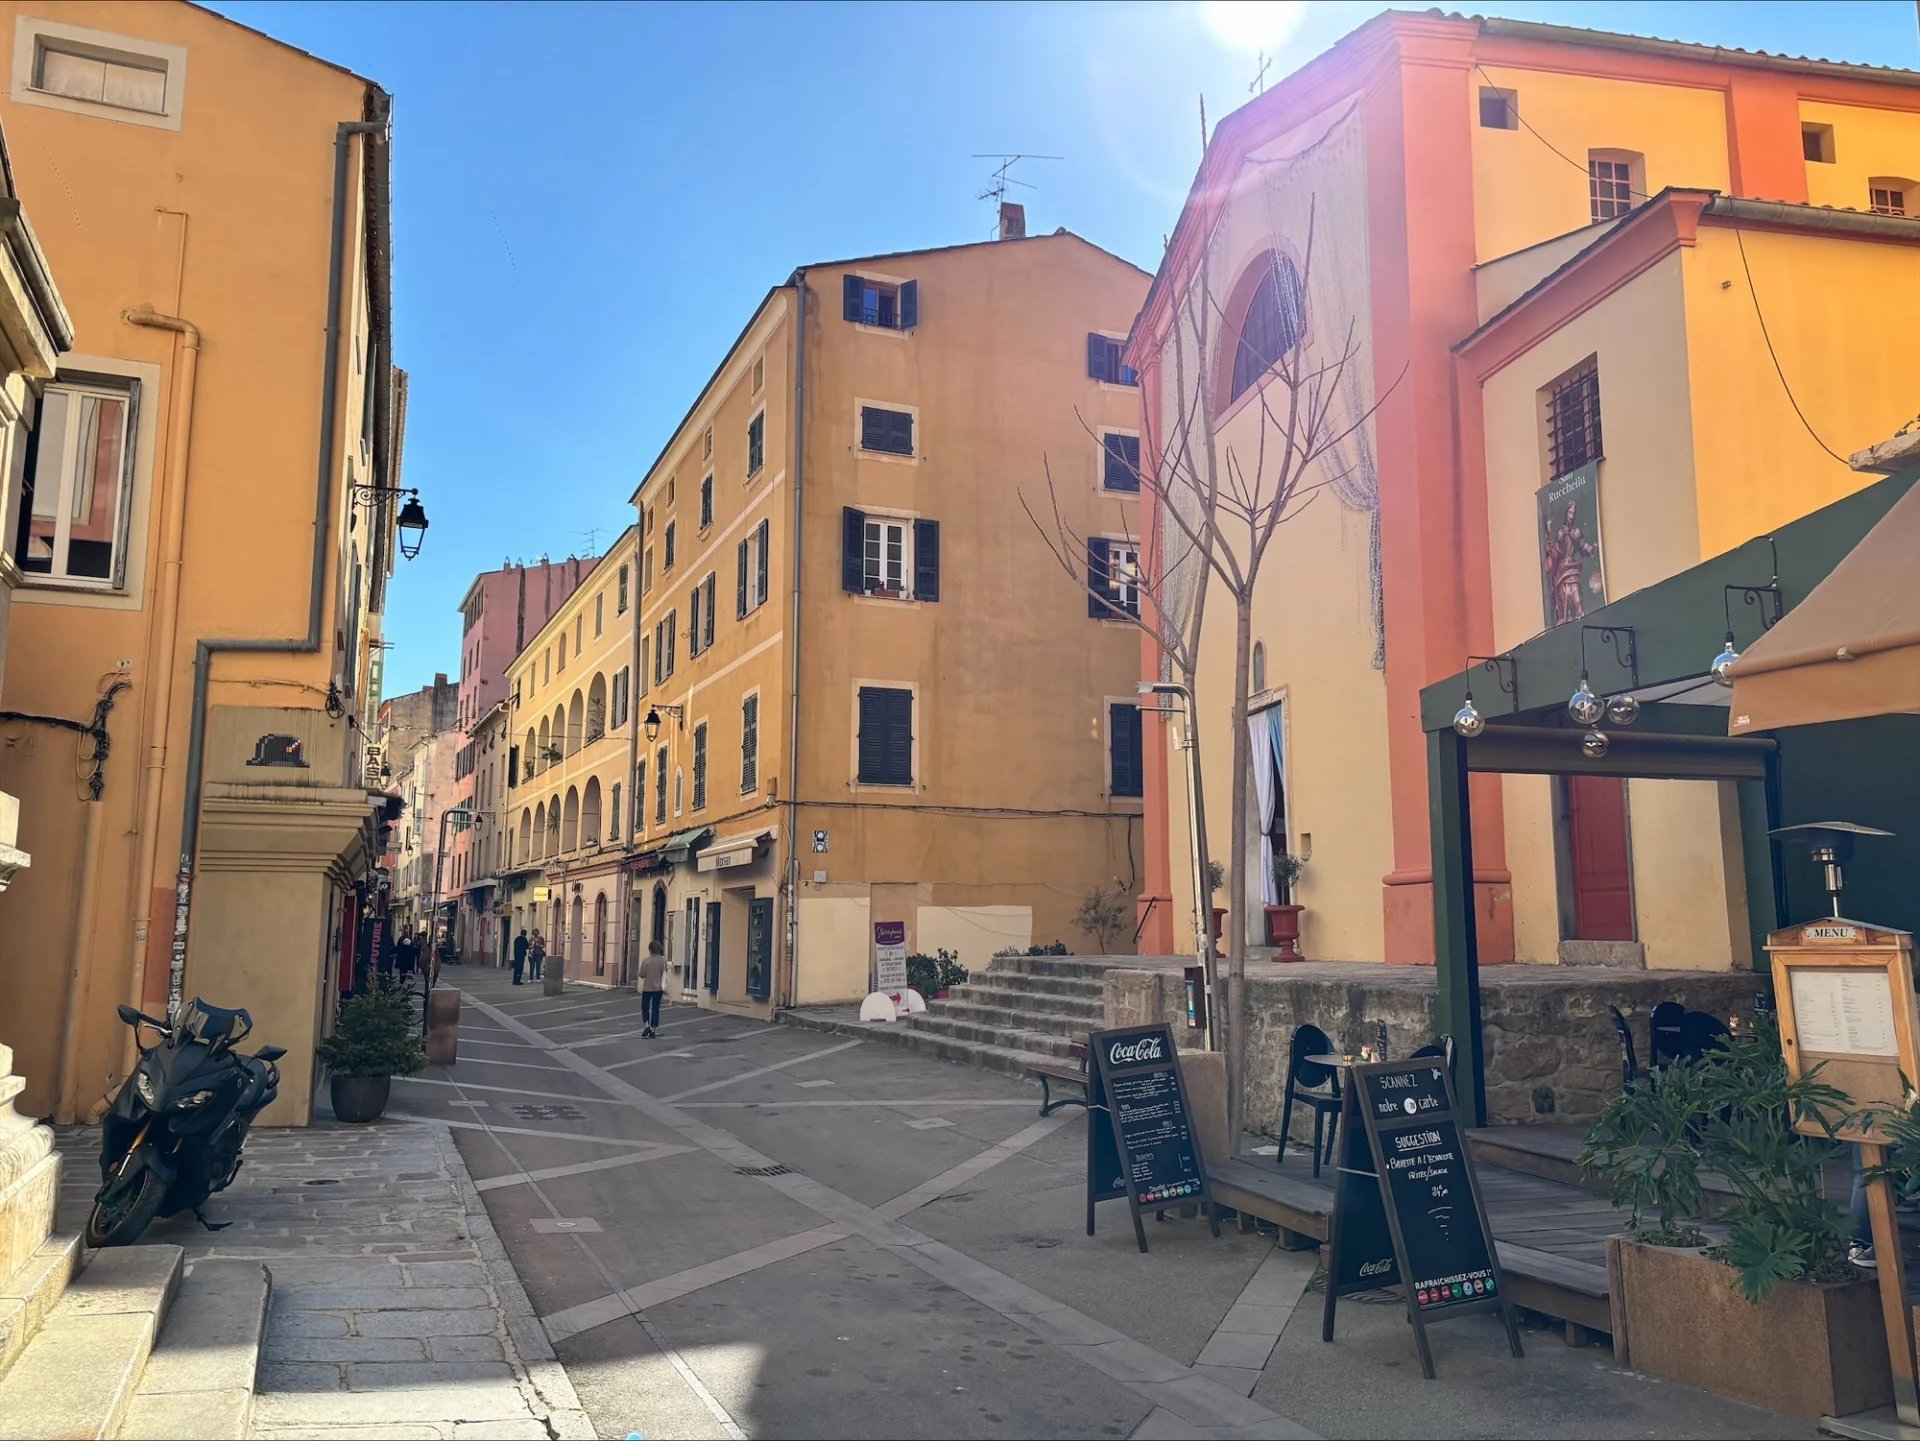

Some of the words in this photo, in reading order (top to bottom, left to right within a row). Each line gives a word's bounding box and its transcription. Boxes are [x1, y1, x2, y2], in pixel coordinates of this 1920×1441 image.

[1814, 928, 1848, 938] MENU
[1110, 1037, 1162, 1065] Coca-Cola
[1380, 1074, 1418, 1090] SCANNEZ
[1378, 1098, 1399, 1113] notre
[1418, 1094, 1439, 1110] carte
[1395, 1130, 1441, 1149] SUGGESTION
